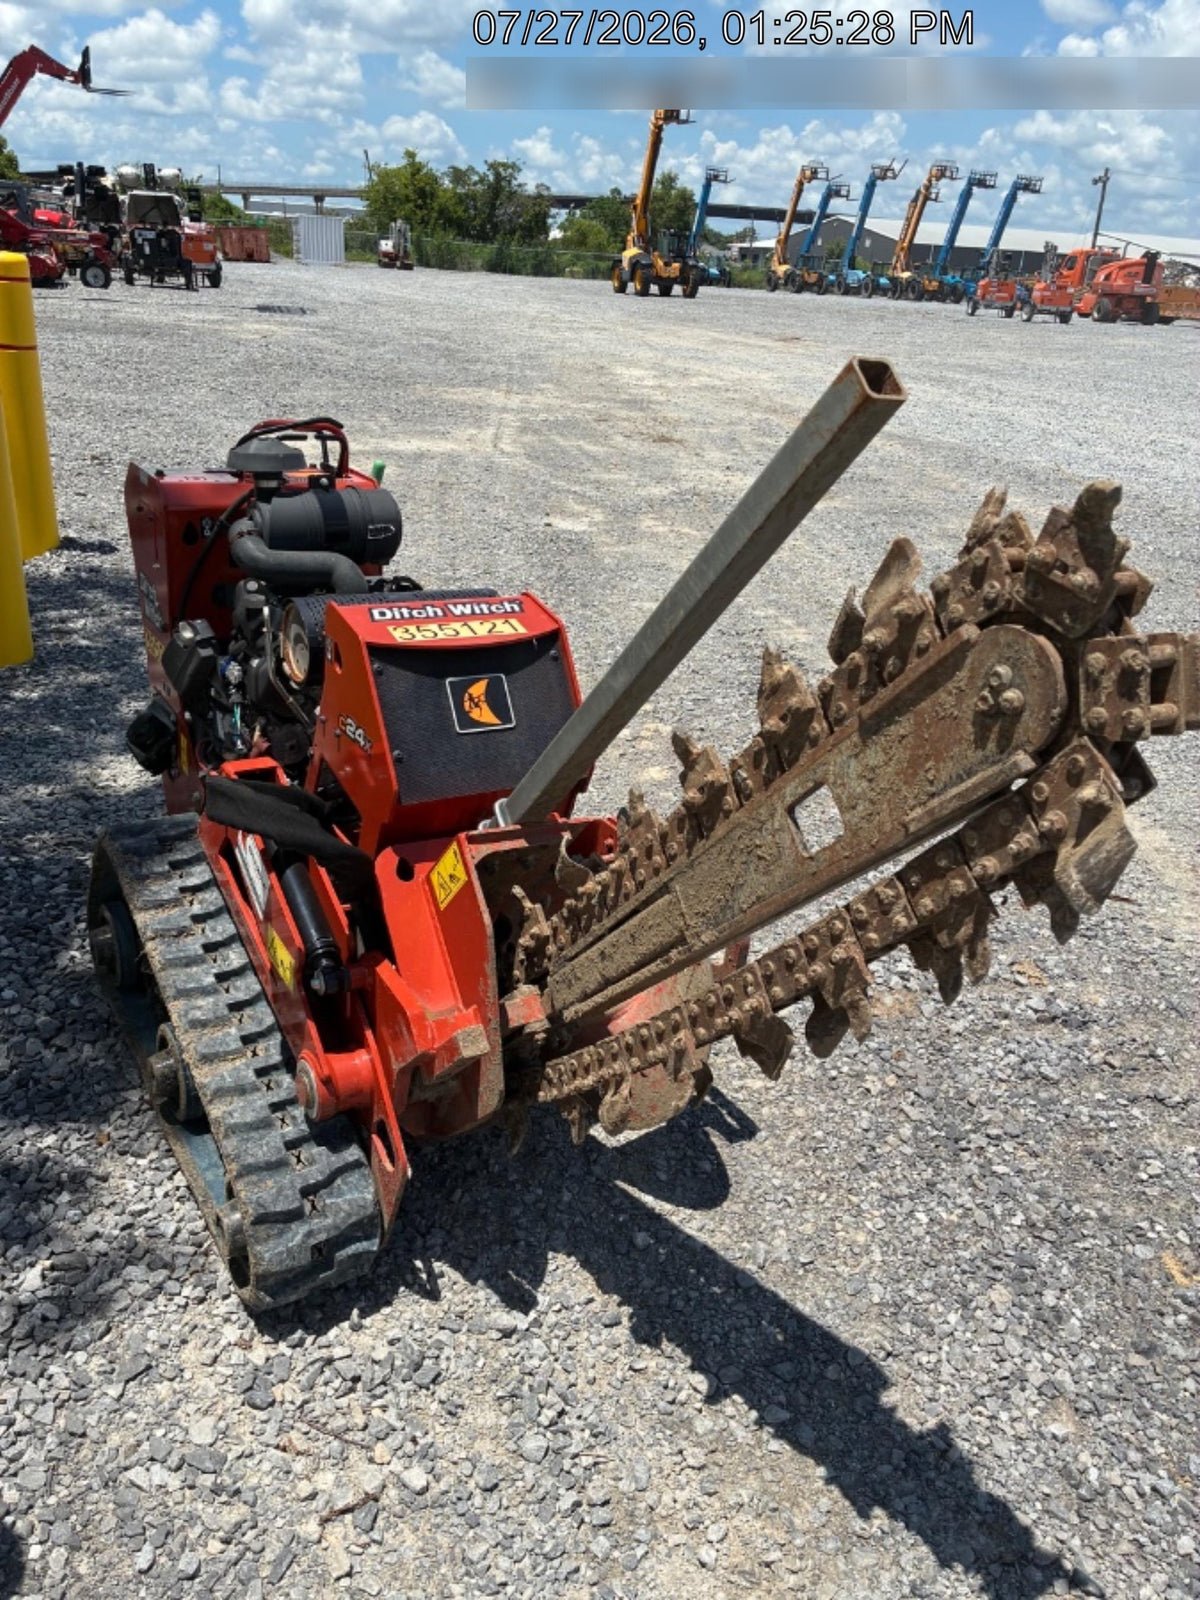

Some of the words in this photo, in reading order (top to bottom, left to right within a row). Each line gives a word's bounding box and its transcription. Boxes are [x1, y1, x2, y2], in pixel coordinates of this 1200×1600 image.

[371, 605, 444, 620] Ditch
[448, 600, 520, 616] Witch
[392, 619, 519, 641] 355121
